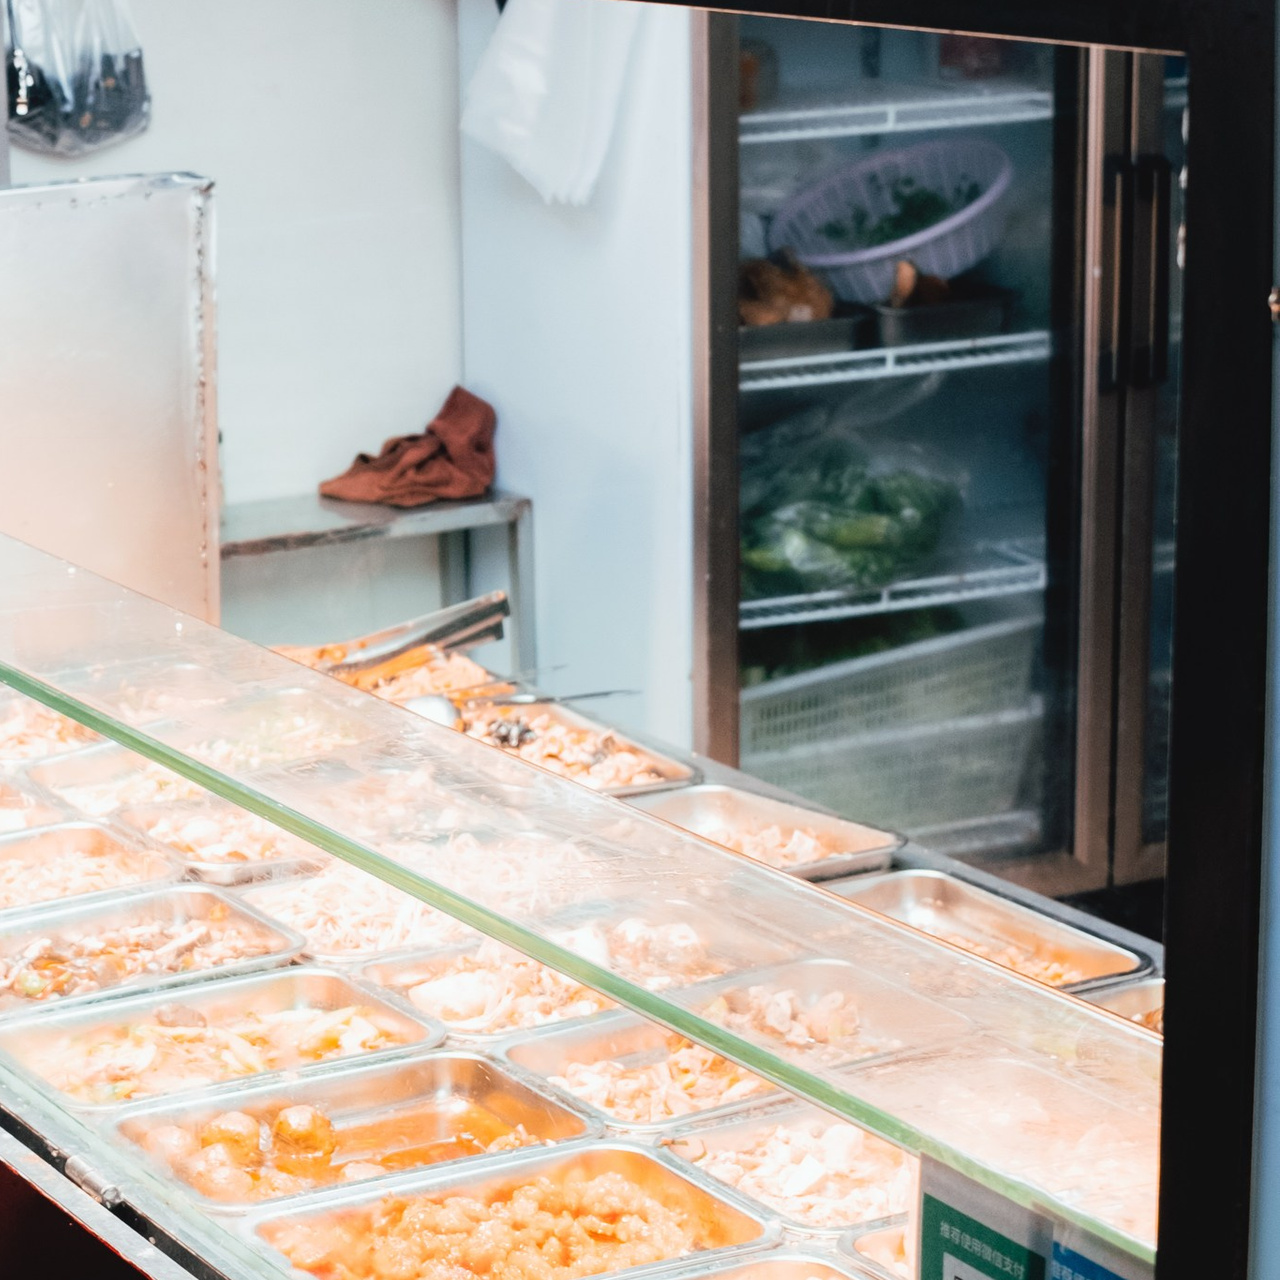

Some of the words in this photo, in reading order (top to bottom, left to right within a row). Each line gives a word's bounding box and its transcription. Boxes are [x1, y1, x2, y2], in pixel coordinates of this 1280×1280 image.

[939, 1221, 1025, 1280] 推荐使用微信支付
